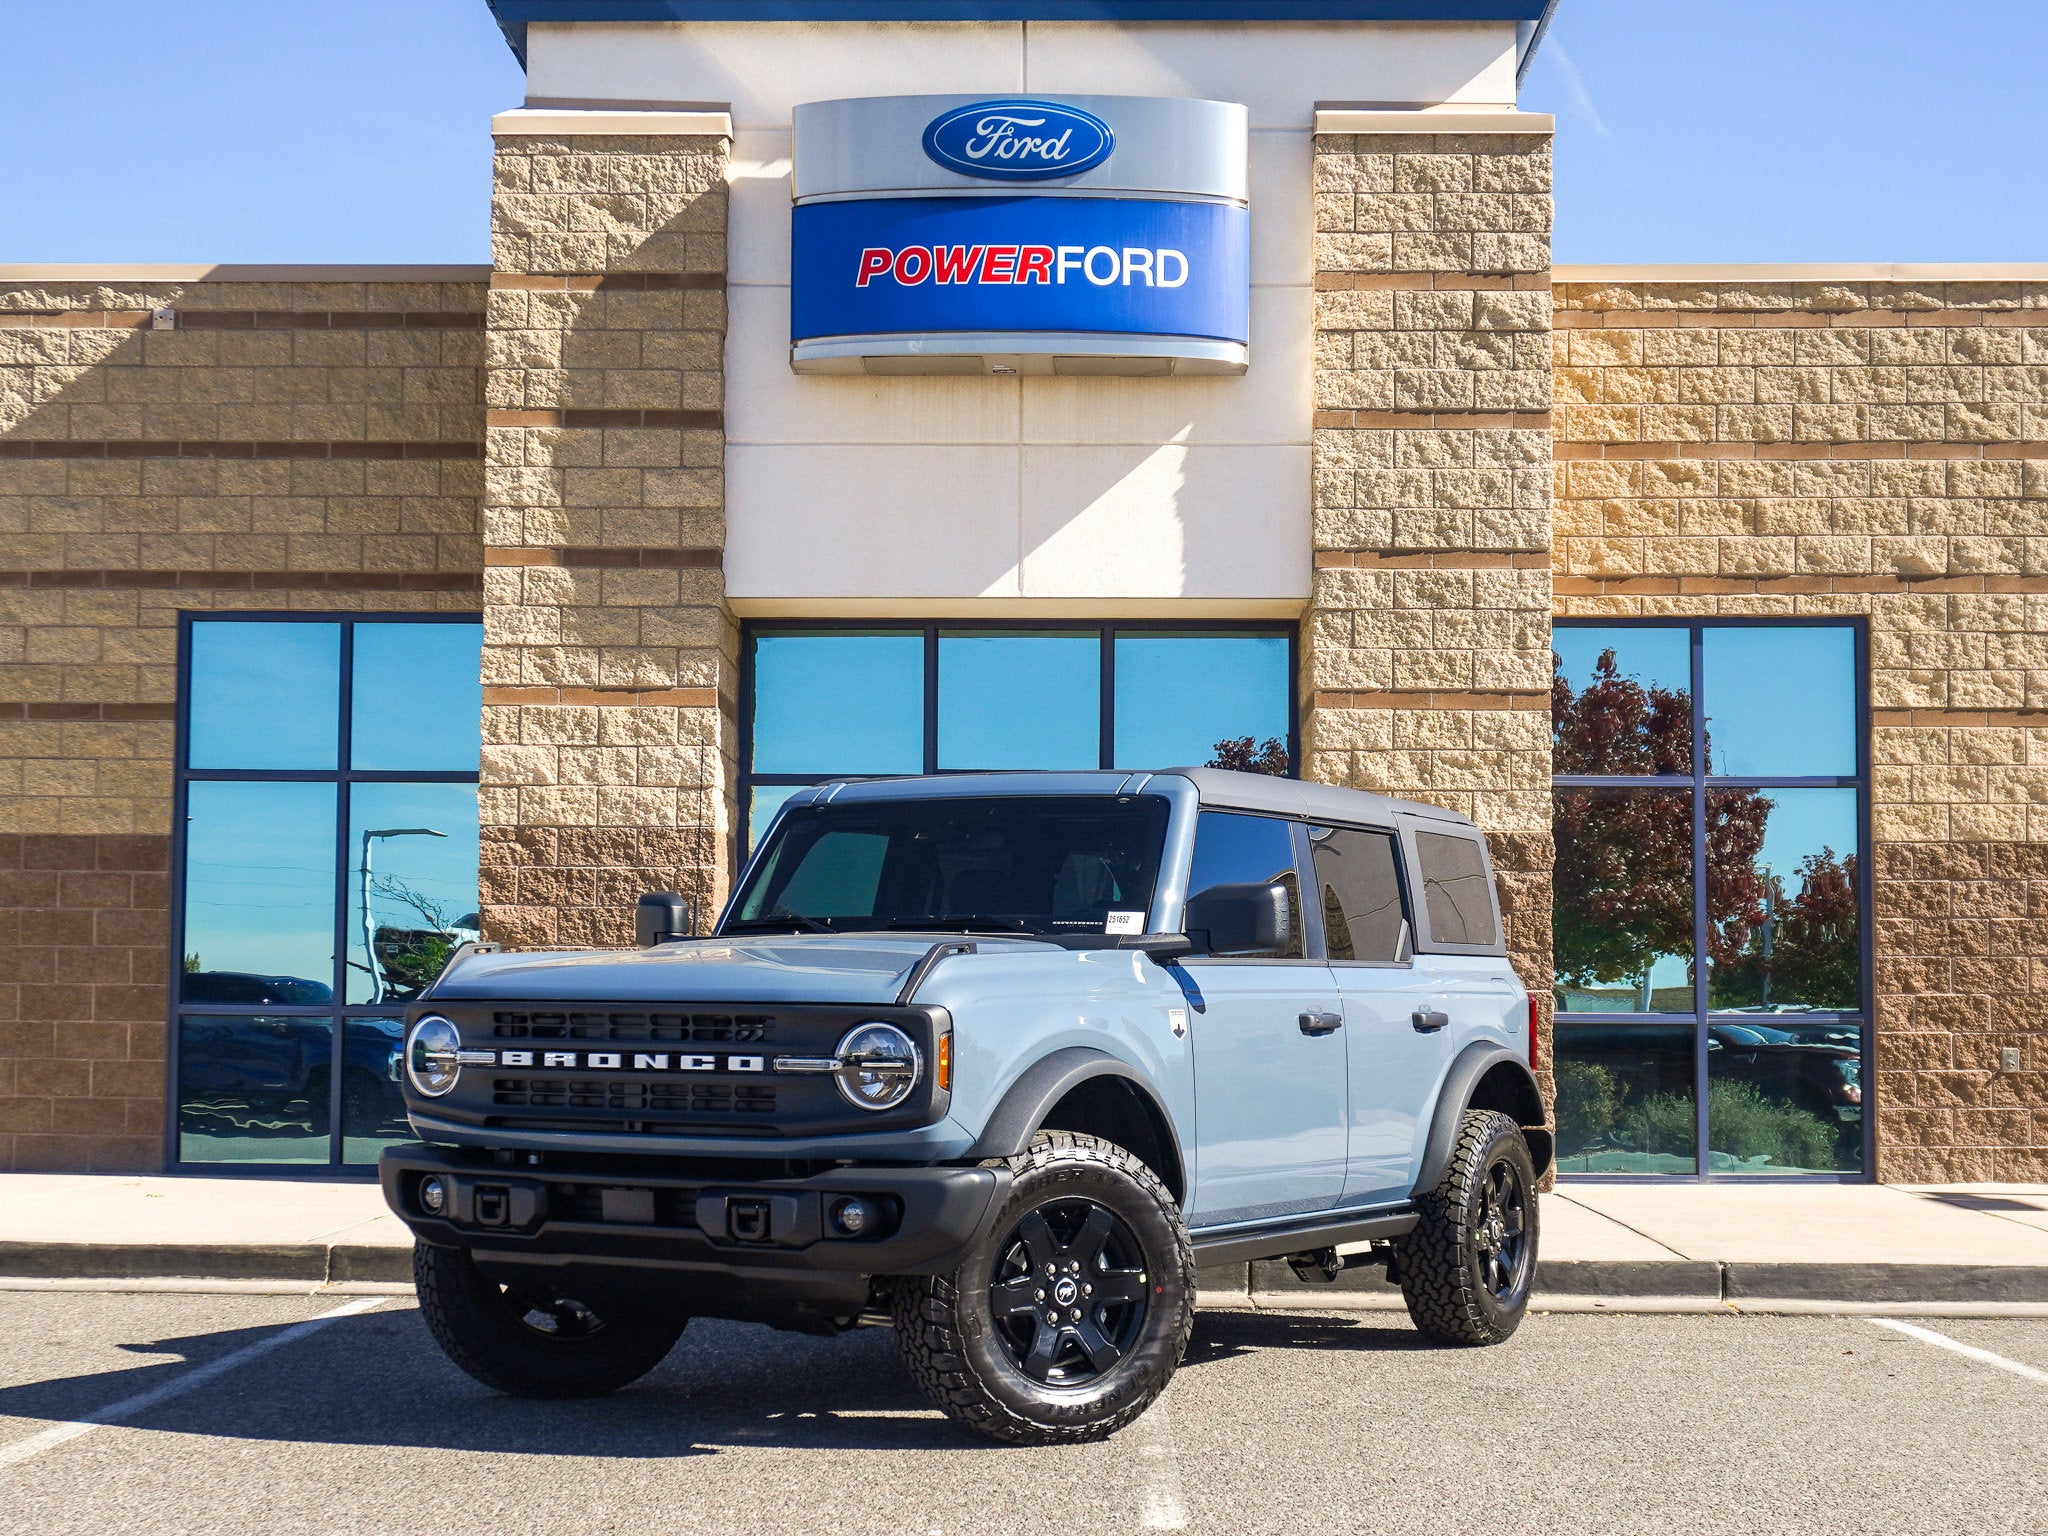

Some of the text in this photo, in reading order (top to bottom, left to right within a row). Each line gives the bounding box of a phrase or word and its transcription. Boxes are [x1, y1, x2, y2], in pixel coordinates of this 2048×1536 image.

[967, 116, 1072, 160] Ford
[1108, 915, 1130, 924] 251652
[502, 1051, 764, 1071] BRONCO
